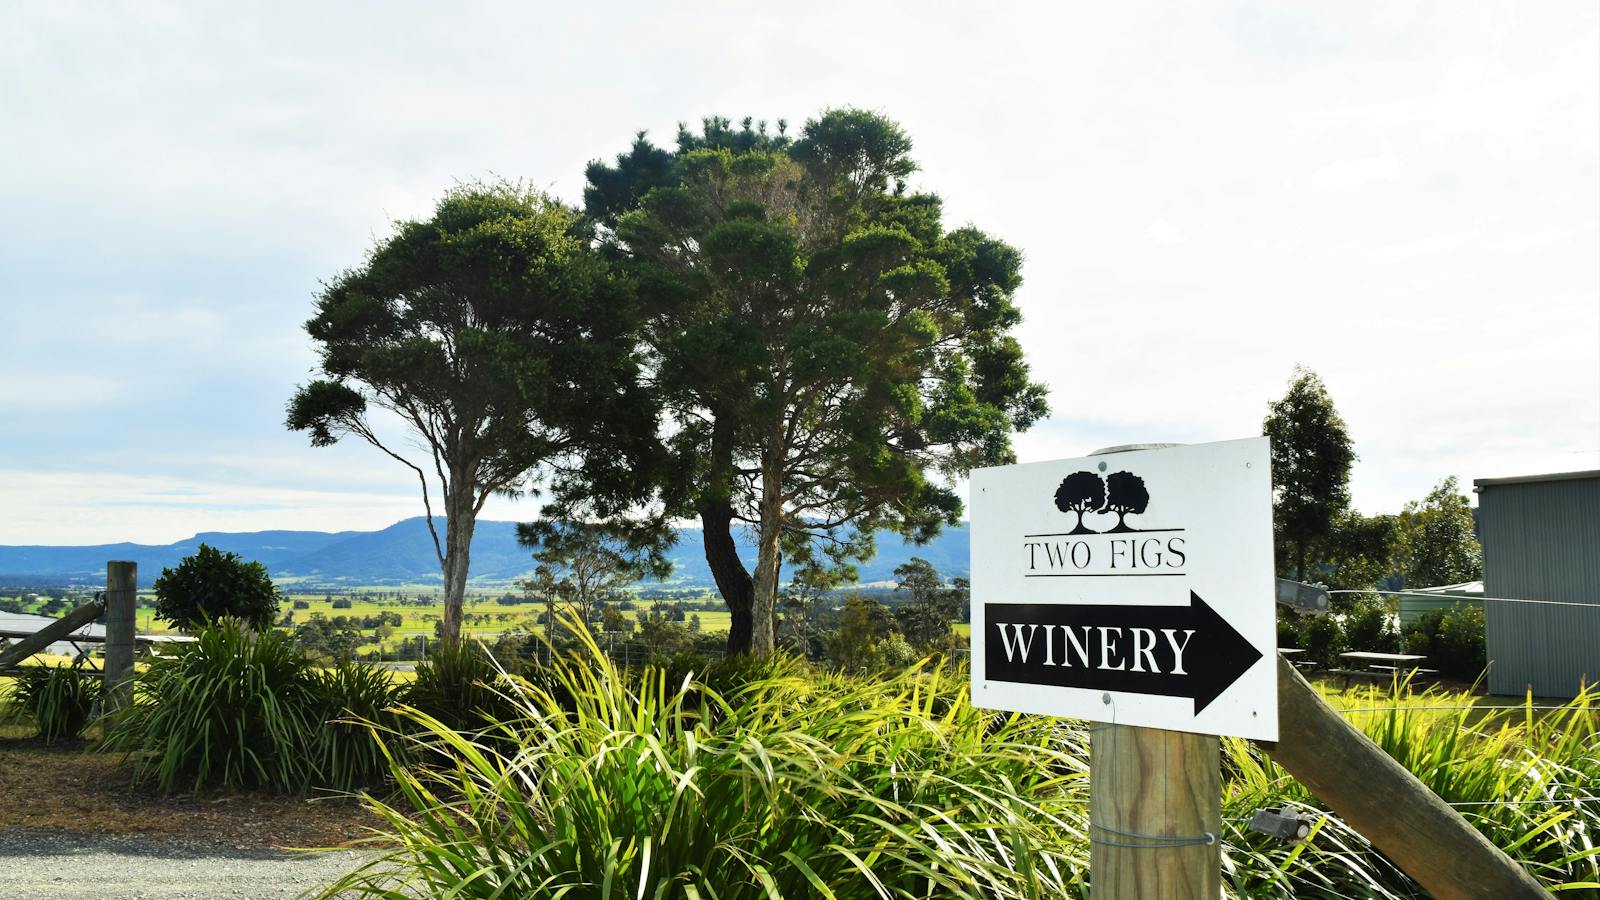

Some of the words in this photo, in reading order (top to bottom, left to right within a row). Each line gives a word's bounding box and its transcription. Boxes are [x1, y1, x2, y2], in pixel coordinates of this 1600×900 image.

[1025, 541, 1091, 570] TWO
[1111, 538, 1186, 569] FIGS
[996, 623, 1196, 676] WINERY
